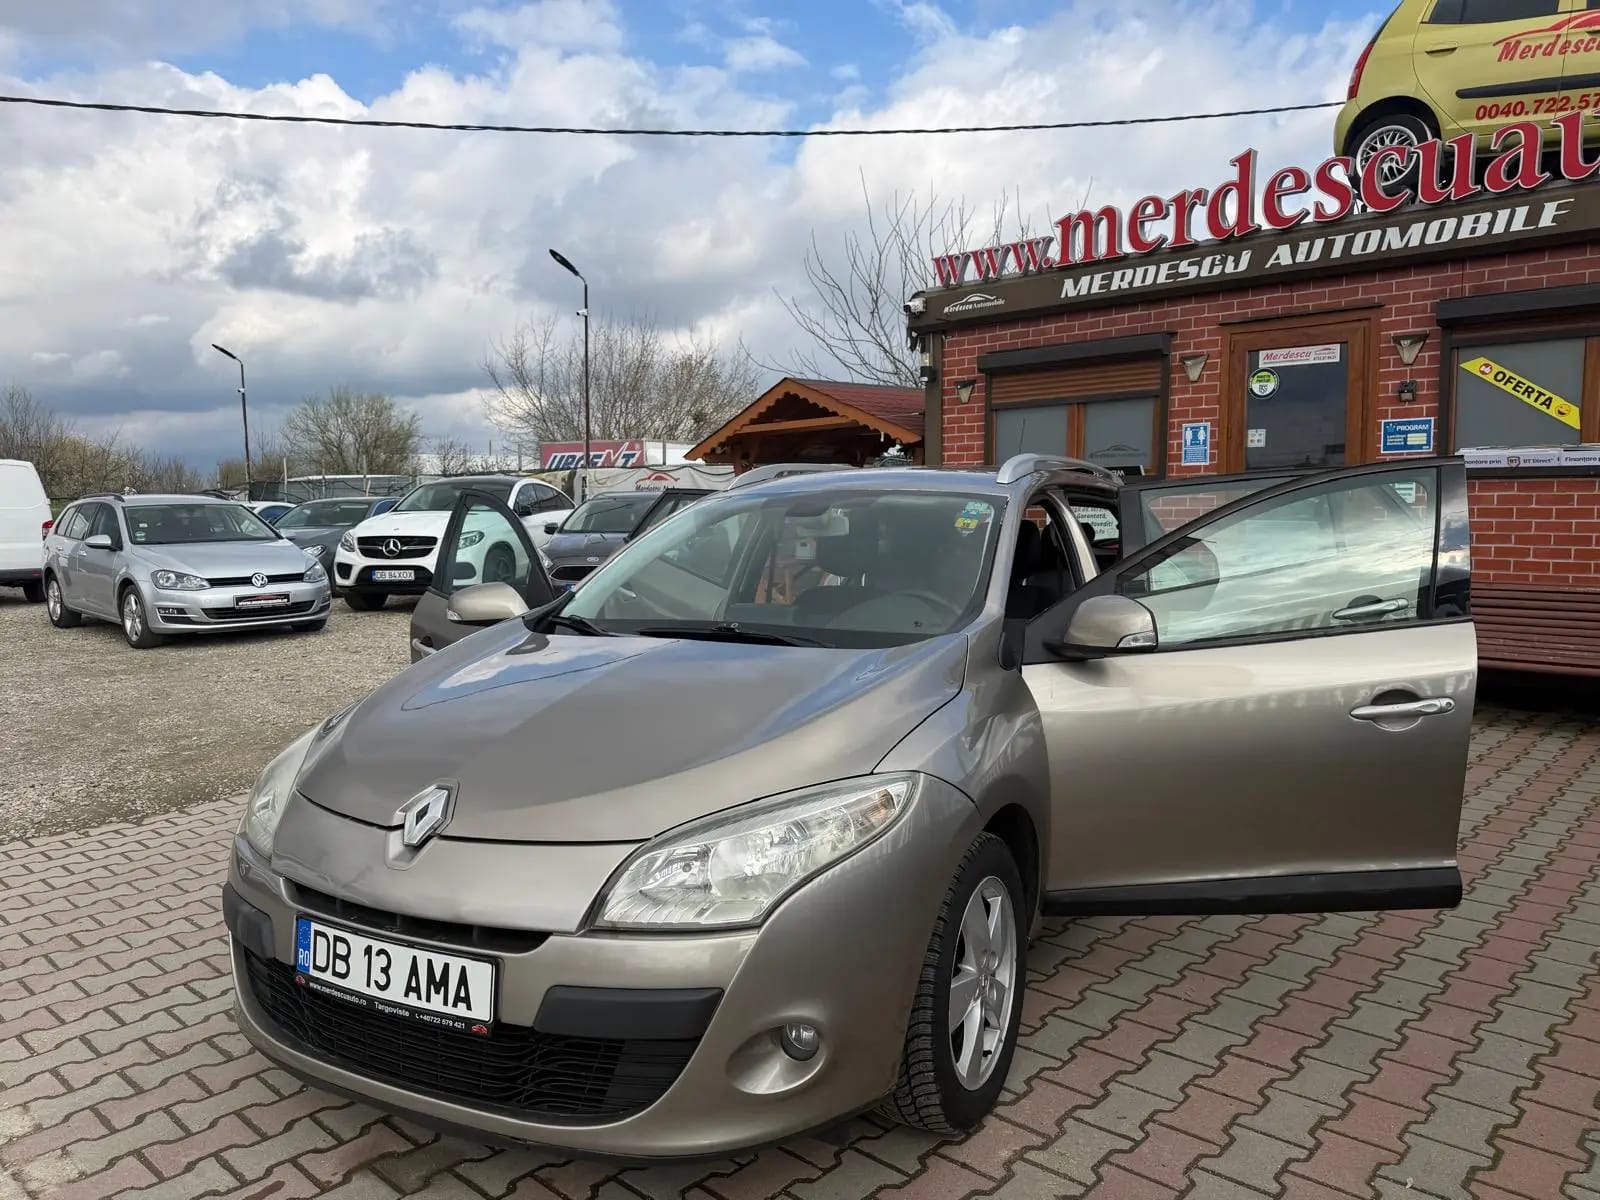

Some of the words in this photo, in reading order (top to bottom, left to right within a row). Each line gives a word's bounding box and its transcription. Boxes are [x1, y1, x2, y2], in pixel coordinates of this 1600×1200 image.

[1060, 250, 1251, 299] MERDESCU
[1264, 198, 1576, 268] AUTOMOBILE
[1263, 350, 1312, 361] Merdescu
[1493, 371, 1554, 410] OFERTA
[298, 948, 310, 967] RO
[313, 929, 351, 979] DB
[363, 945, 392, 991] 13
[404, 955, 473, 1011] AMA
[309, 981, 367, 1006] www.merdescuauto.ro
[374, 1002, 410, 1017] Targoviste
[441, 1018, 453, 1027] 579
[453, 1021, 465, 1029] 421
